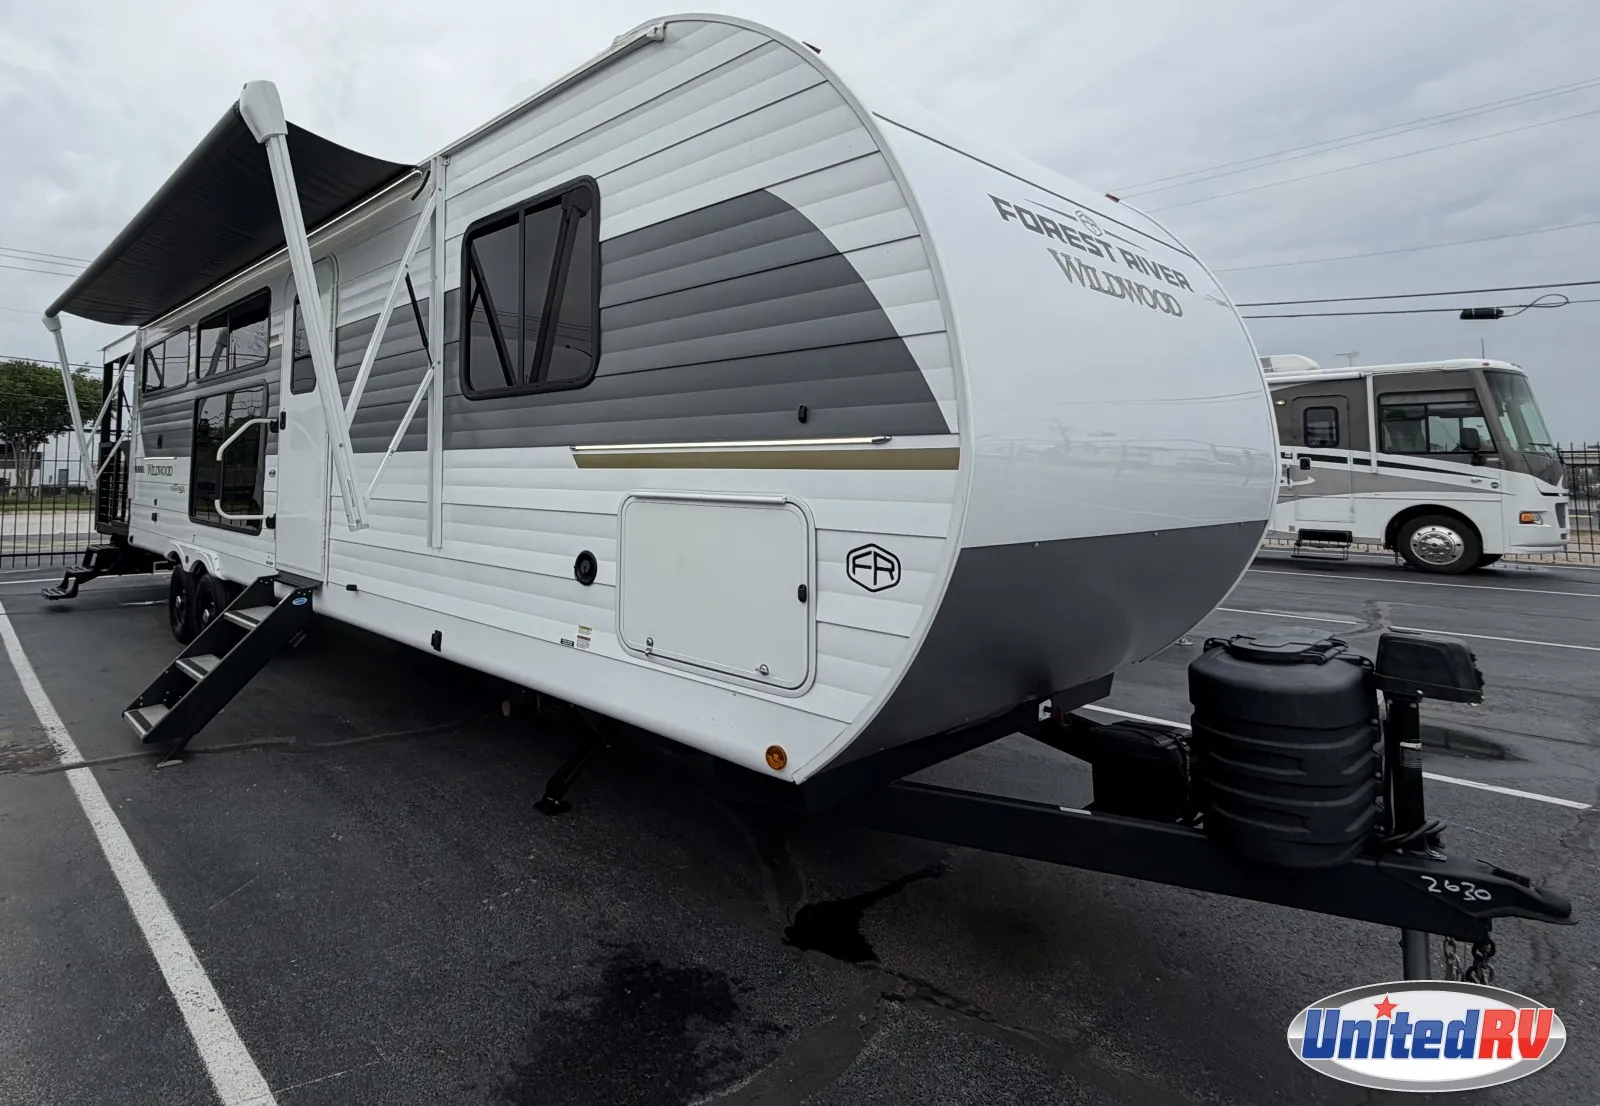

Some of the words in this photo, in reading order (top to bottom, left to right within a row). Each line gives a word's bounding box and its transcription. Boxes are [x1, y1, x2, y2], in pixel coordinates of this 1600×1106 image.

[987, 194, 1117, 263] FOREST
[1115, 246, 1195, 293] RIVER
[1046, 247, 1183, 317] WILDWOOD
[850, 548, 897, 587] FR
[1420, 875, 1492, 900] 2630
